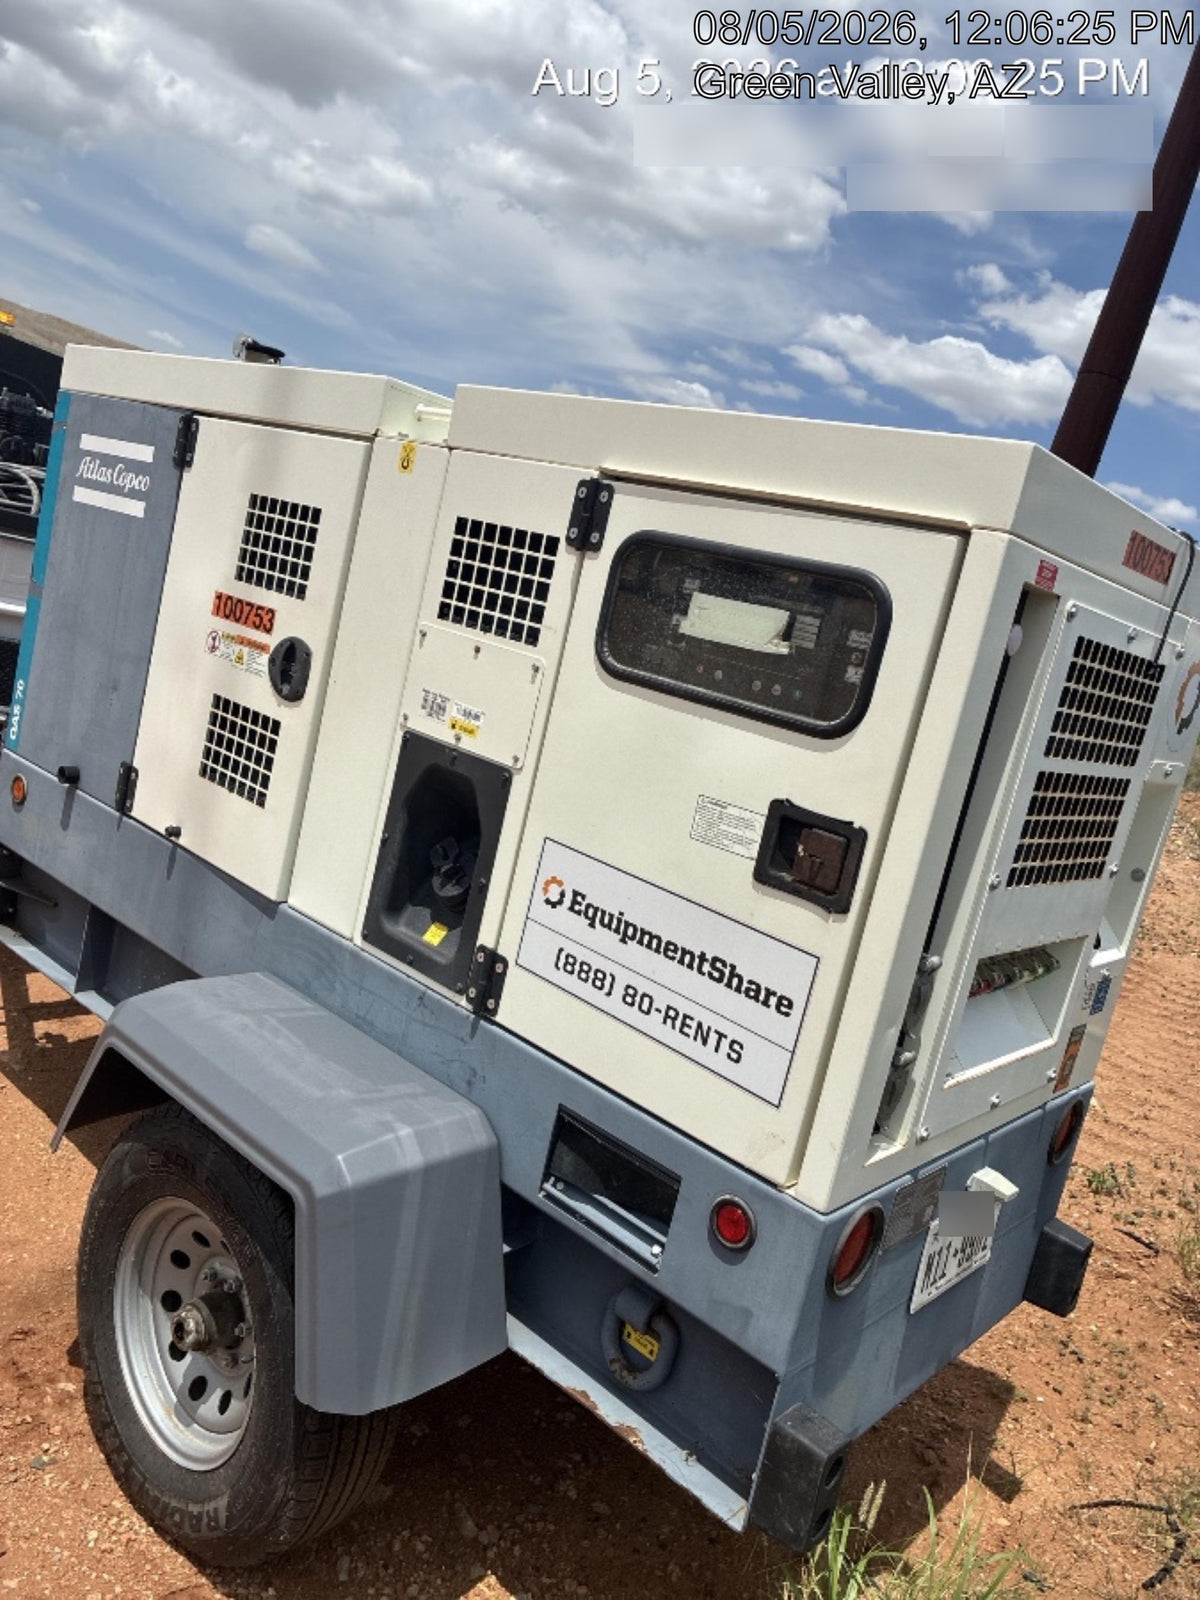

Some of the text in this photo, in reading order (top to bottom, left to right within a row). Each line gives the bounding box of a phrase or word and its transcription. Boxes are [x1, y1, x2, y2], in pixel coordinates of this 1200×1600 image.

[76, 456, 150, 493] Atlas Copco
[213, 591, 276, 635] 100753
[10, 704, 21, 740] QAS
[567, 889, 794, 1018] EquipmentShare
[554, 947, 745, 1065] (888) 80-RENTS
